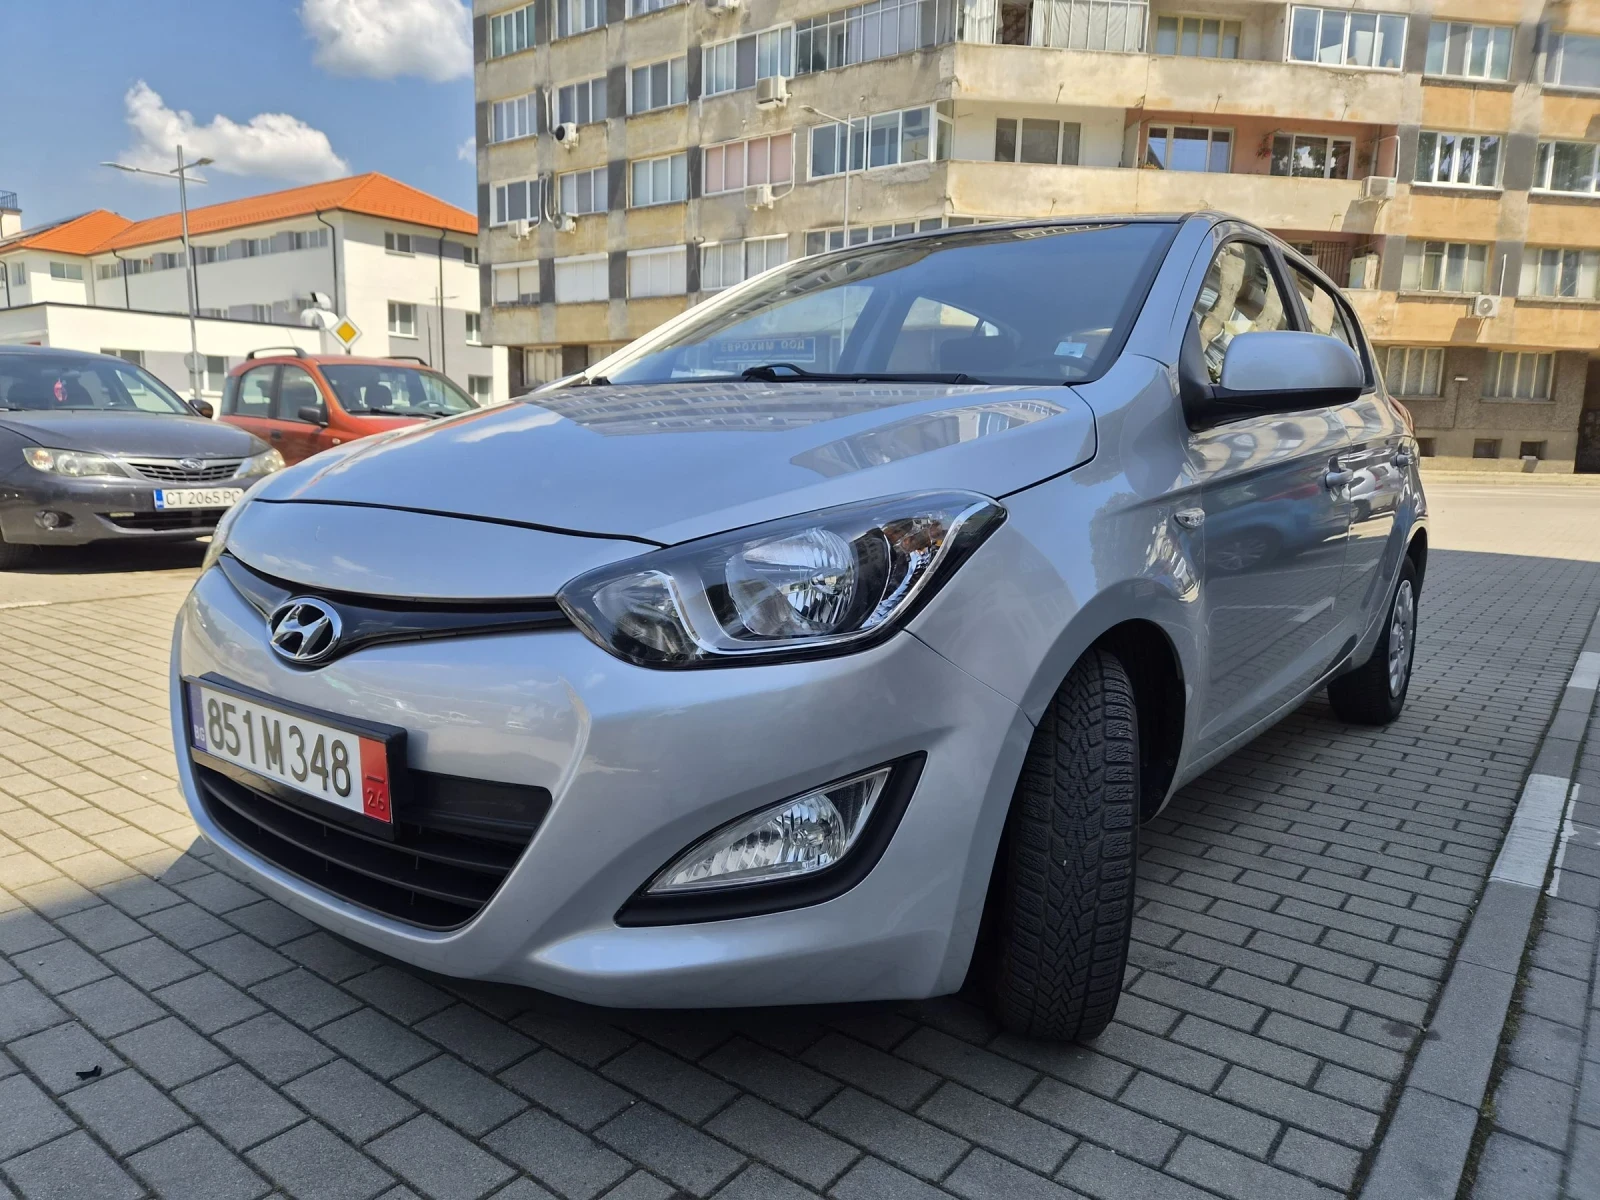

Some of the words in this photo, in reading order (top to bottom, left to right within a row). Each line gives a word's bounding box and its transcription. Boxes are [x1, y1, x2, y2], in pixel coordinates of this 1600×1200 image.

[188, 491, 220, 505] 2065
[194, 724, 205, 742] BG
[366, 787, 385, 812] 26
